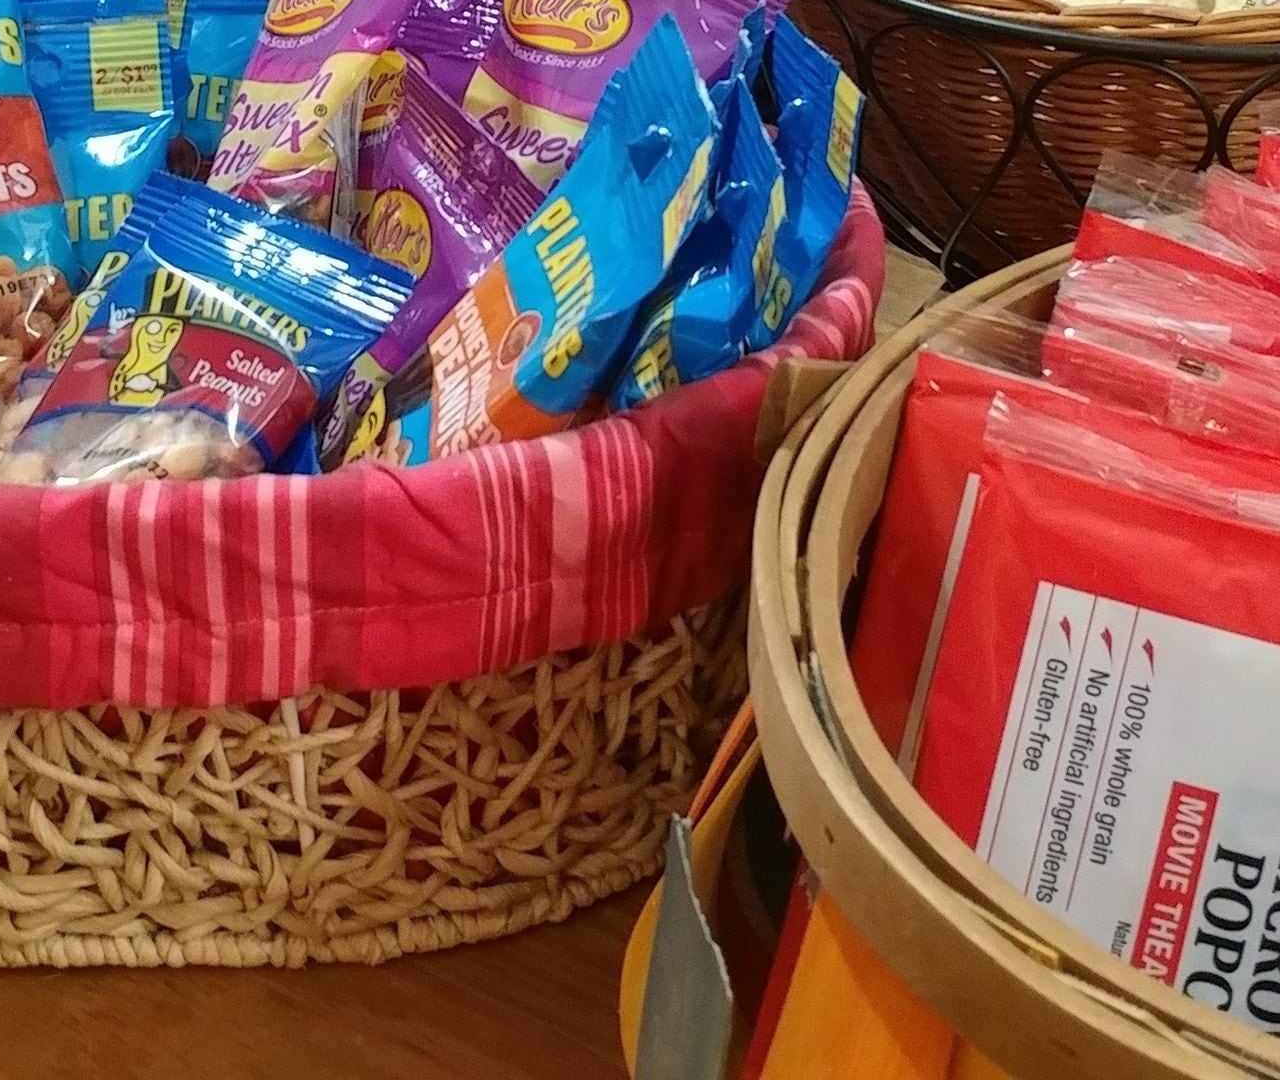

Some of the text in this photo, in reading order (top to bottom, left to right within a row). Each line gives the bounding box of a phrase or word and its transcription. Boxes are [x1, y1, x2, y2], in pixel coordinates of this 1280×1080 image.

[148, 266, 312, 353] PLANTERS
[188, 358, 268, 408] Peanuts
[226, 348, 285, 386] Salted
[1021, 656, 1068, 773] Gluten-free
[1034, 667, 1111, 905] No artificial ingredients
[1088, 681, 1153, 867] 100% whole grain
[1158, 793, 1208, 890] MOVIE
[1182, 841, 1268, 1015] POPC
